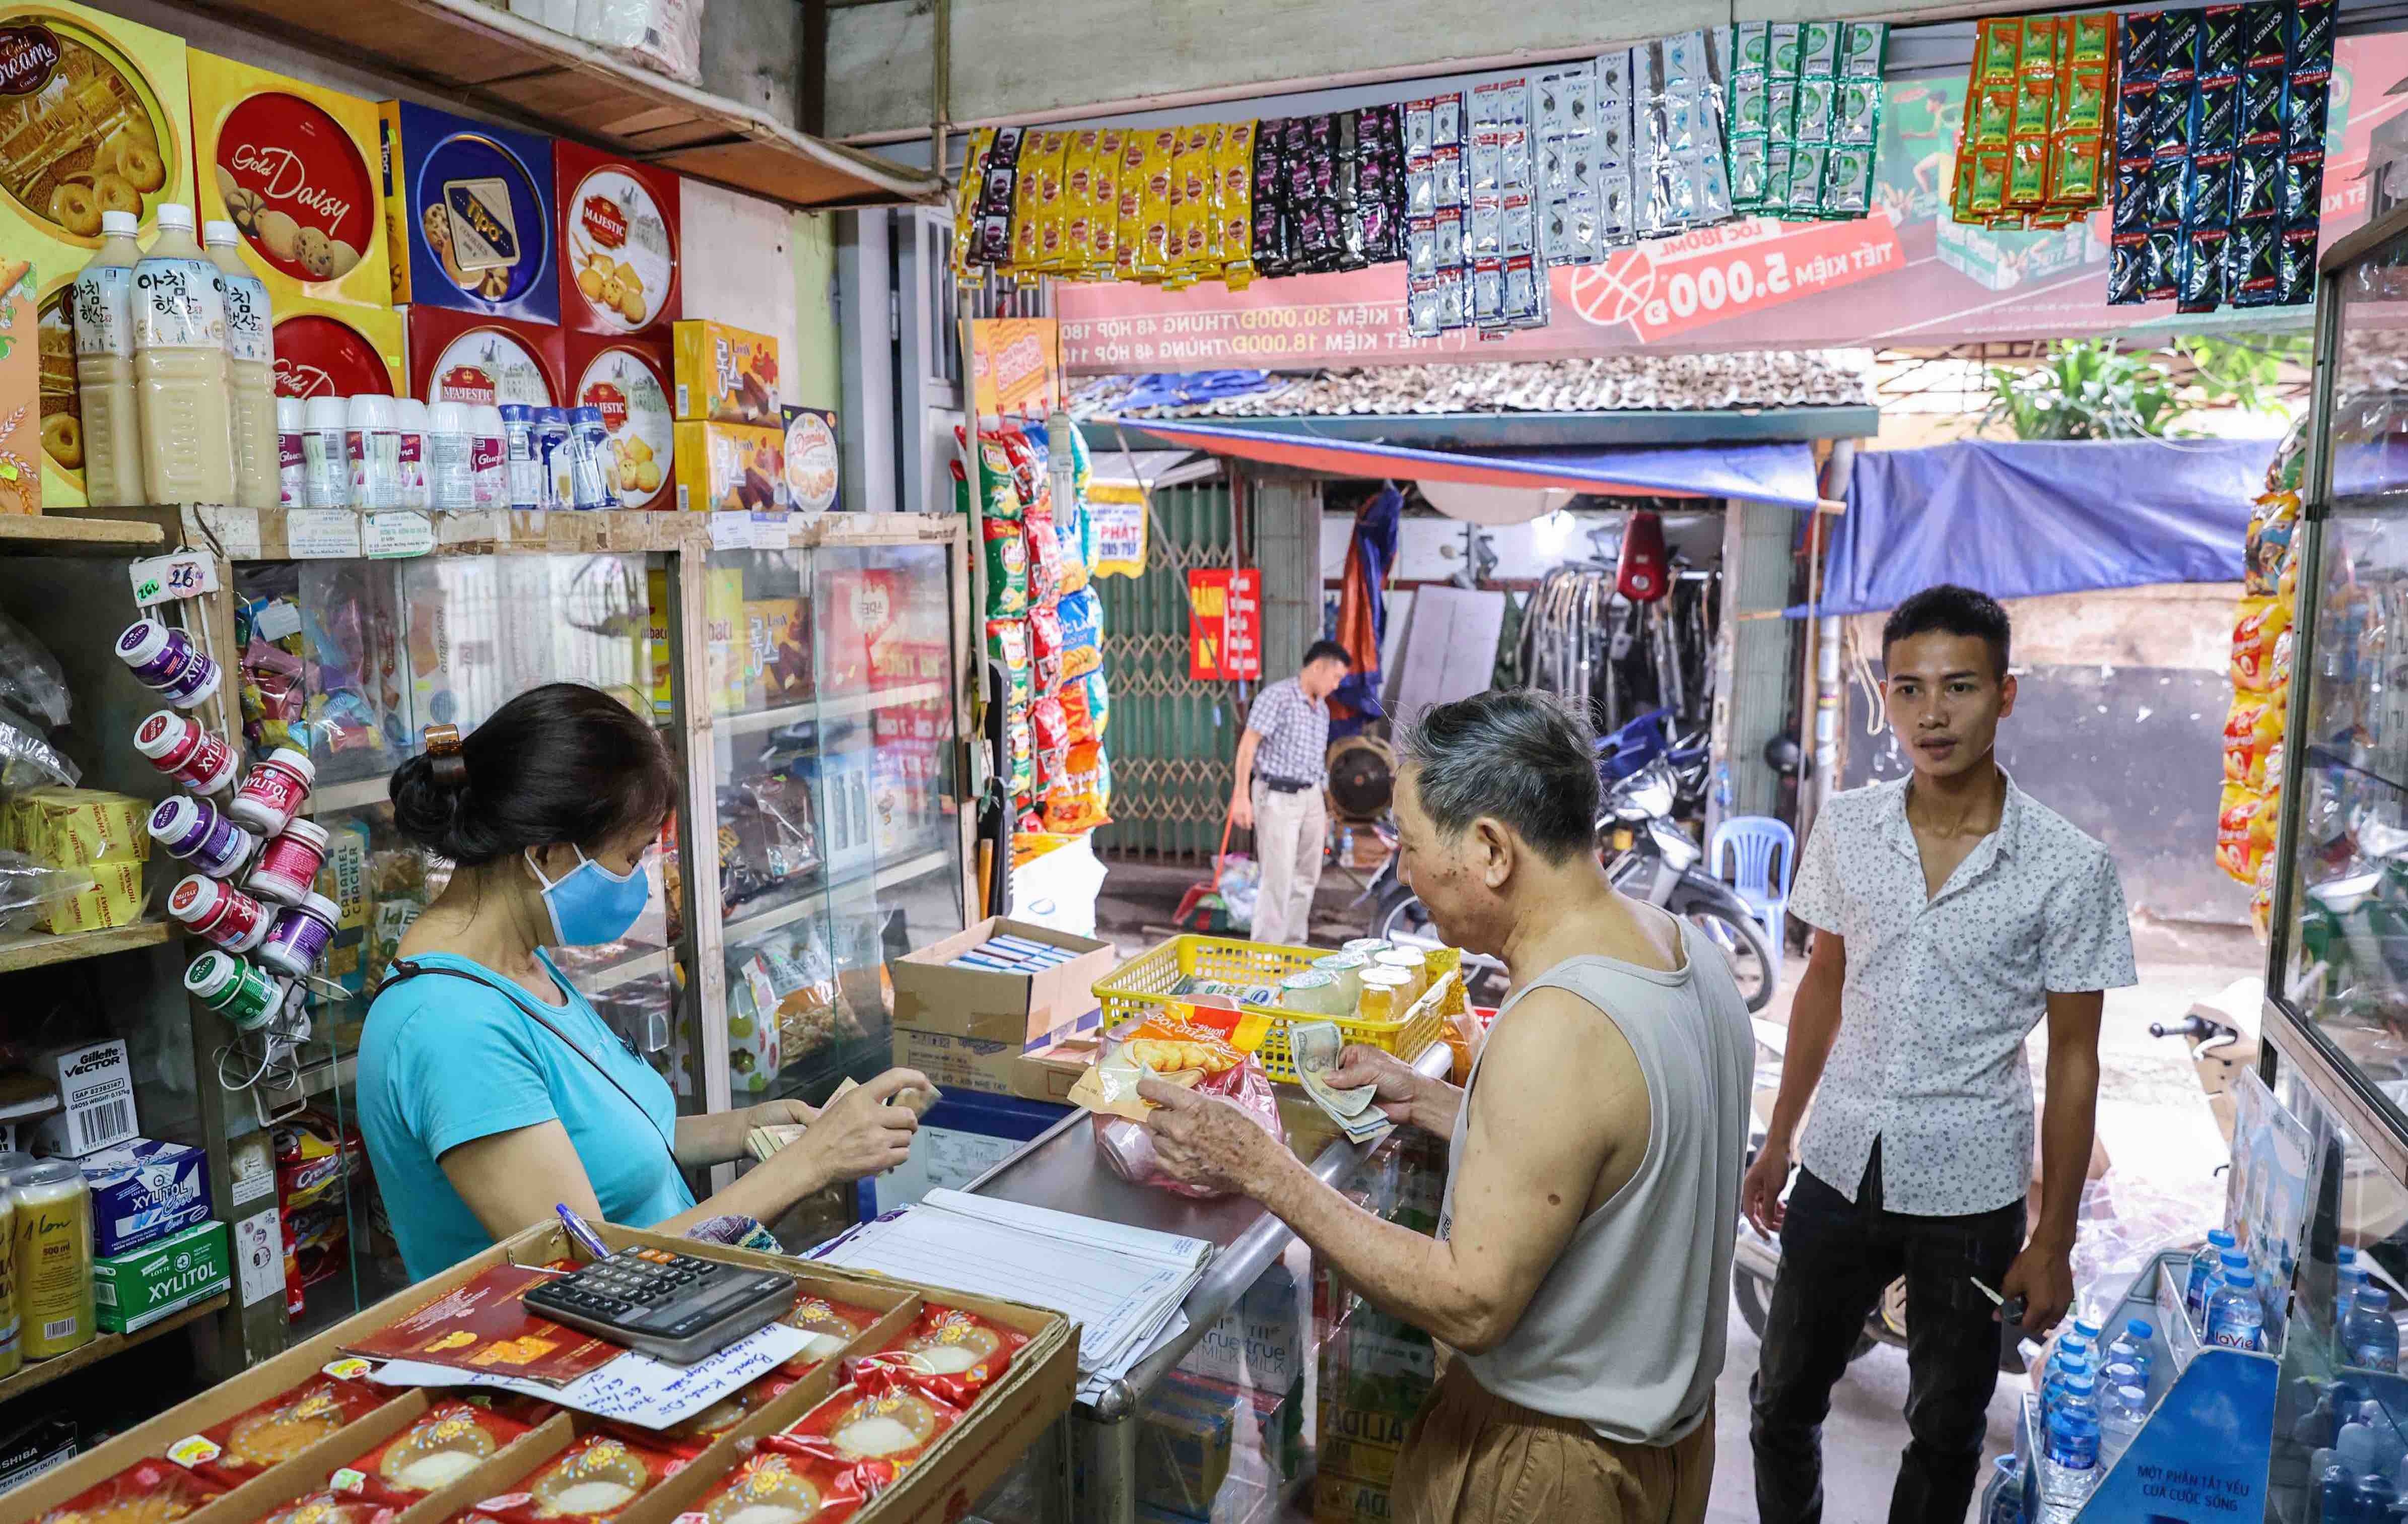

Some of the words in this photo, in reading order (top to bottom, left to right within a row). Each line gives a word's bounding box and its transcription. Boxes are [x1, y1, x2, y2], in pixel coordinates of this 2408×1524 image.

[232, 144, 276, 177] Gold
[261, 147, 351, 236] Daisy
[584, 205, 626, 239] MAJESTIC
[138, 270, 185, 296] 아침
[443, 385, 494, 402] MAJESTIC
[124, 626, 146, 649] XYLITOL
[159, 802, 174, 828] XYLITOL
[339, 844, 350, 918] CARAMEL
[349, 846, 361, 914] CRACKER
[193, 957, 213, 981] XYLITOL
[64, 1056, 120, 1078] VECTOR
[80, 1048, 118, 1064] Gillette
[71, 1101, 88, 1110] GROSS
[75, 1090, 88, 1099] SAP
[132, 1181, 188, 1211] XYLITOL
[149, 1261, 218, 1304] XYLITOL
[151, 1266, 170, 1278] LOTTE
[1246, 1337, 1285, 1361] true
[0, 1446, 38, 1470] SHIBA
